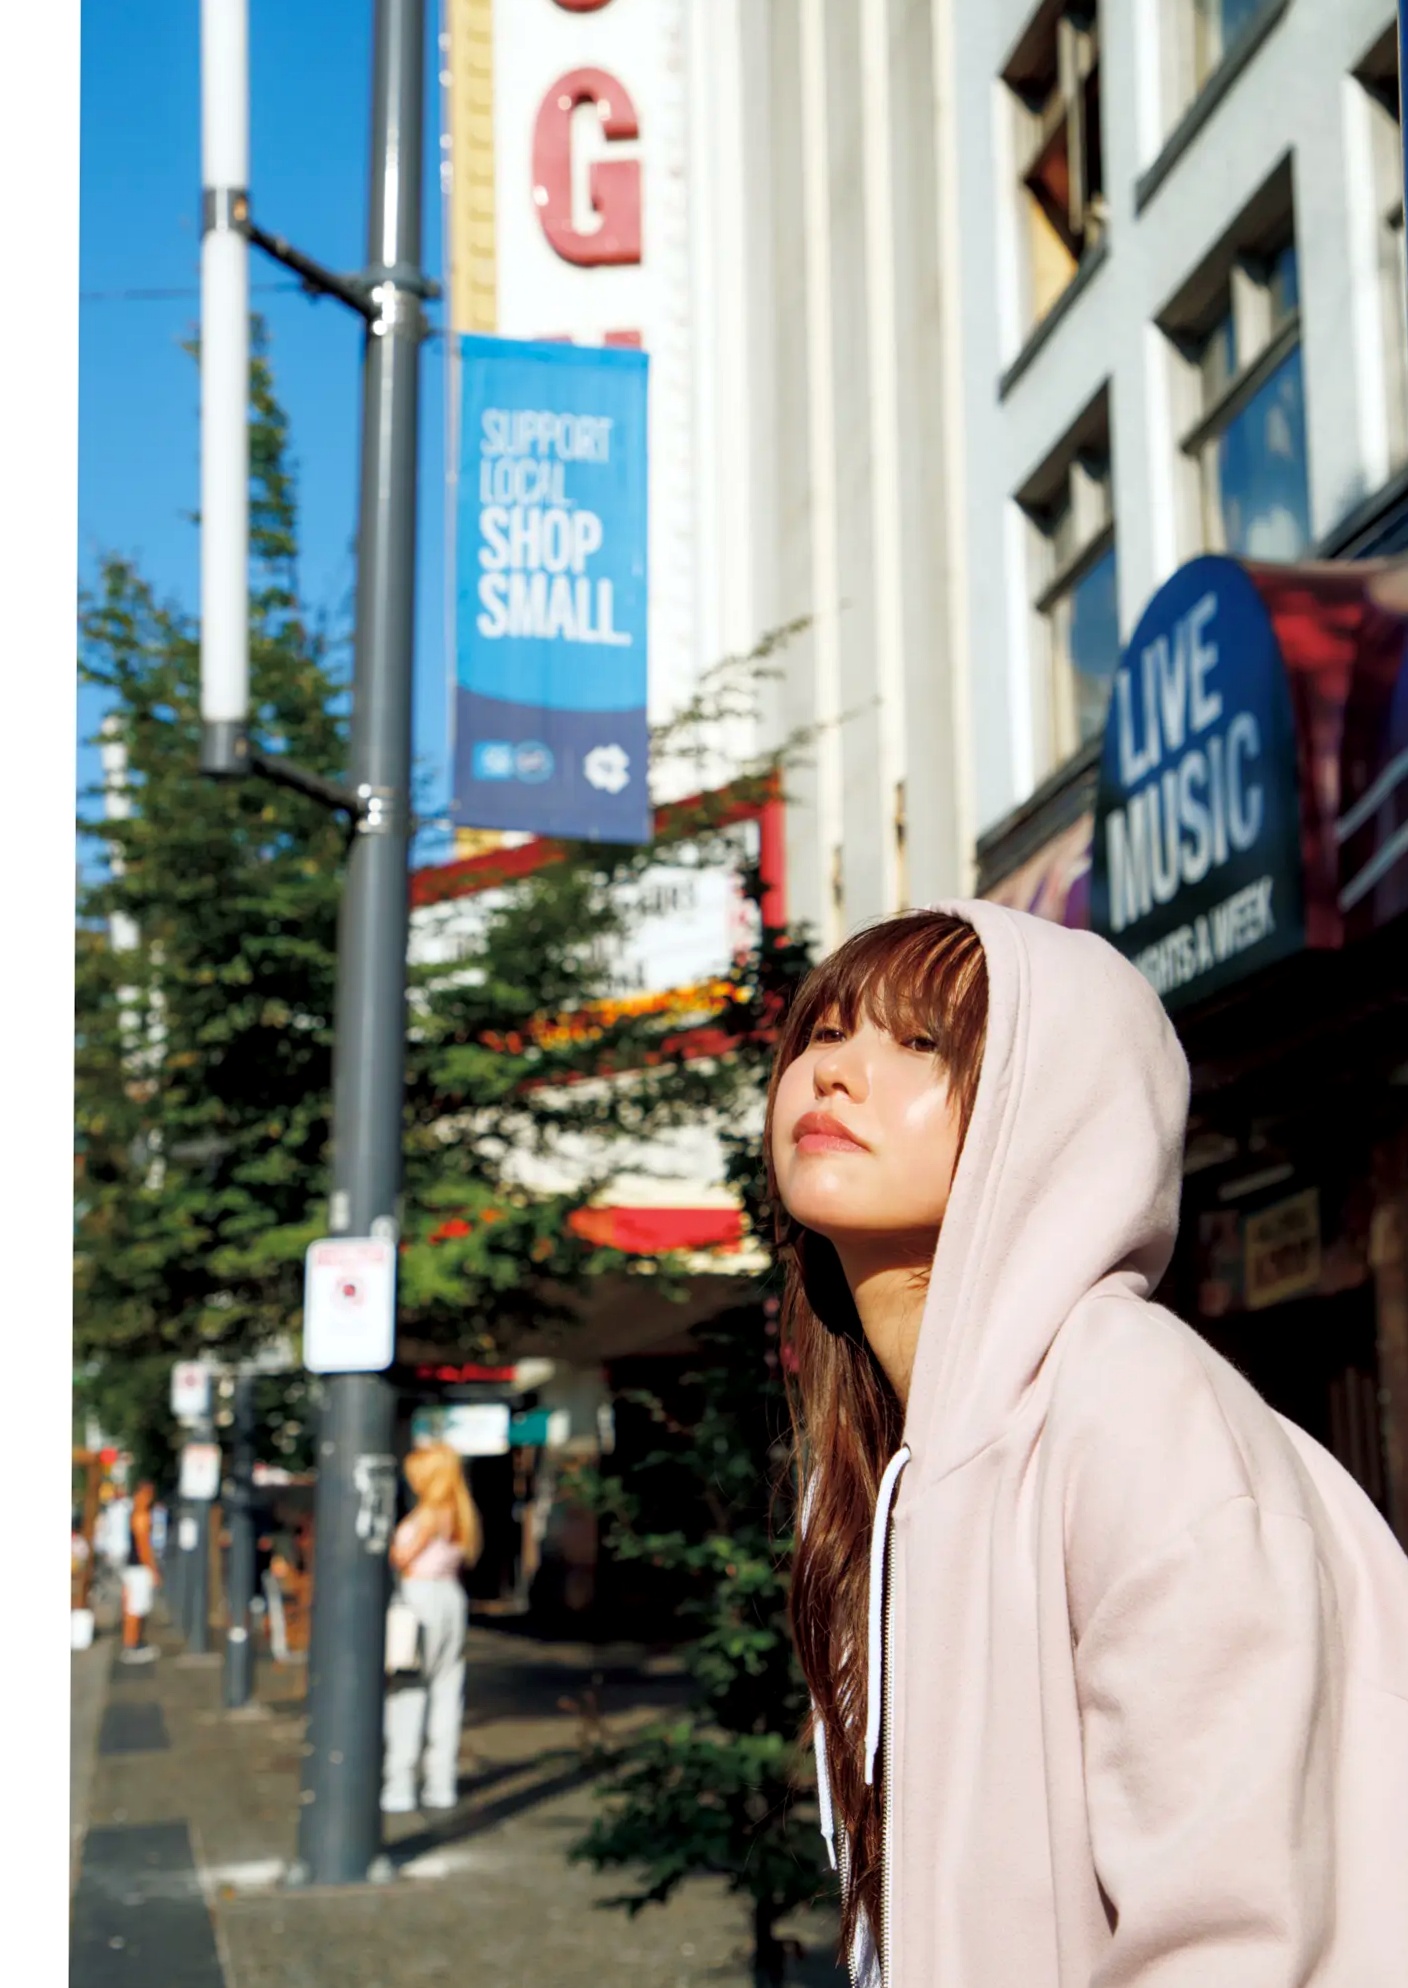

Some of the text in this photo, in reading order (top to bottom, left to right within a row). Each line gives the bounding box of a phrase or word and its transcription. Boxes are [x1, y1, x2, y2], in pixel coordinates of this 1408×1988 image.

[480, 408, 613, 463] SUPPORT
[480, 457, 575, 506] LOCAL
[477, 505, 604, 575] SHOP
[476, 572, 634, 648] SMALL
[1119, 593, 1222, 784] LIVE
[1107, 713, 1261, 932] MUSIC
[1193, 914, 1214, 974] A
[1209, 875, 1275, 961] WEEK
